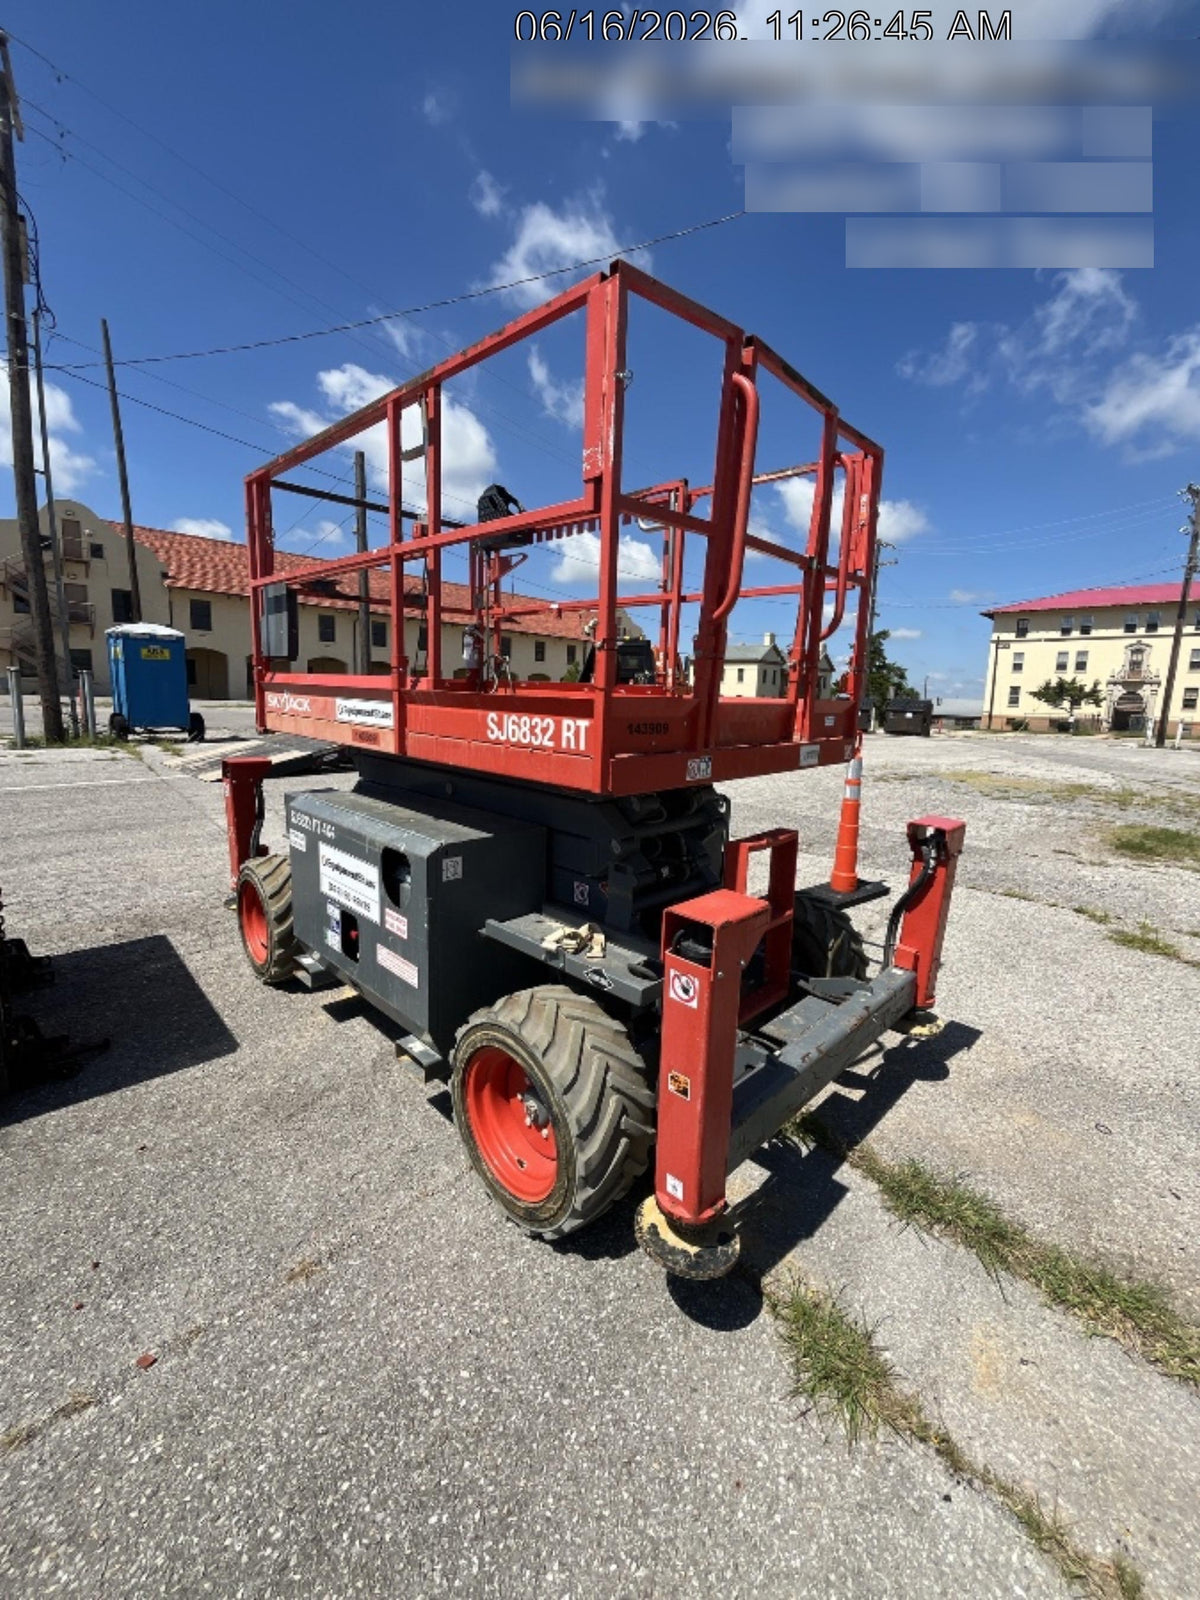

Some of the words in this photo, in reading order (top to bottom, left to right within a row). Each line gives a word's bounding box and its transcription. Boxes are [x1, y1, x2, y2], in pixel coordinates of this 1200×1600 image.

[267, 690, 311, 712] SKYJACK
[486, 712, 555, 747] SJ6832
[561, 718, 590, 751] RT
[627, 722, 670, 736] 143909
